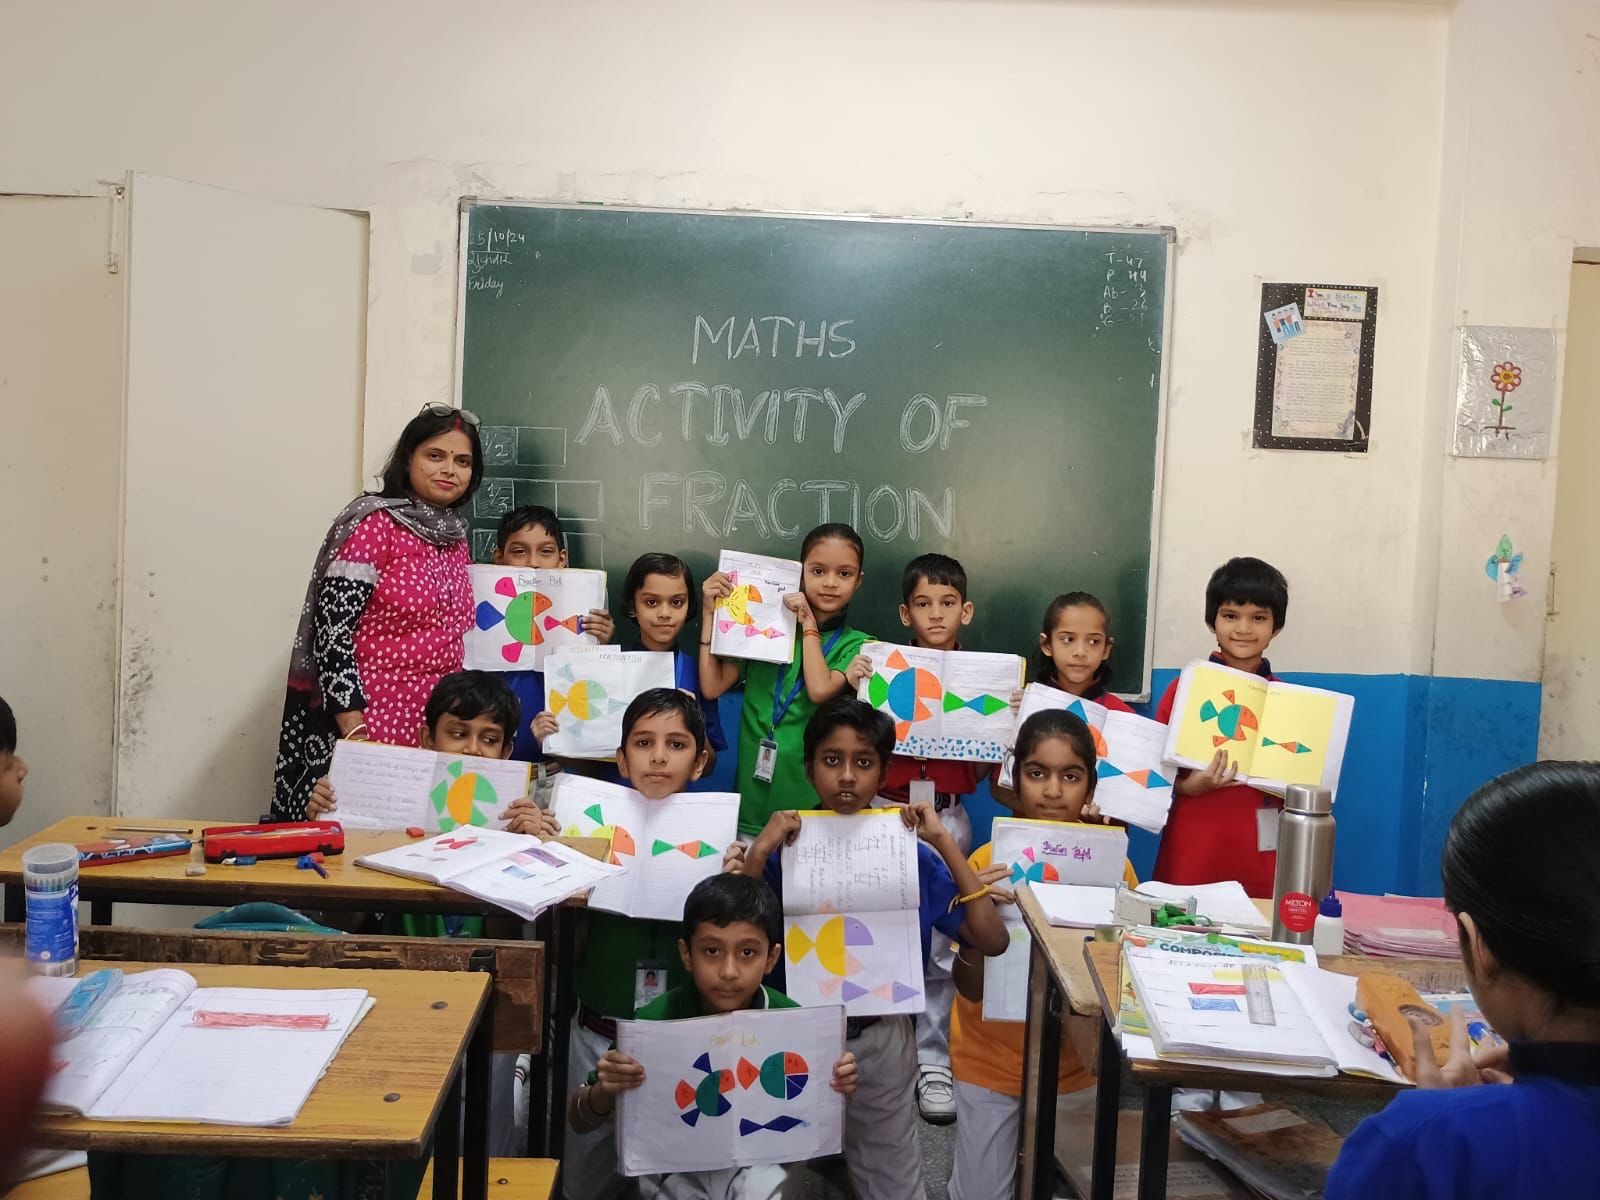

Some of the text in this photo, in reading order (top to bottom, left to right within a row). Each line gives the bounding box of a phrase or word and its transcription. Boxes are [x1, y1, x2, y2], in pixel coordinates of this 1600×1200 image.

[468, 275, 504, 300] Friday
[691, 314, 857, 365] MATHS
[574, 383, 988, 454] ACTIVITY OF
[637, 470, 956, 543] FRACTION
